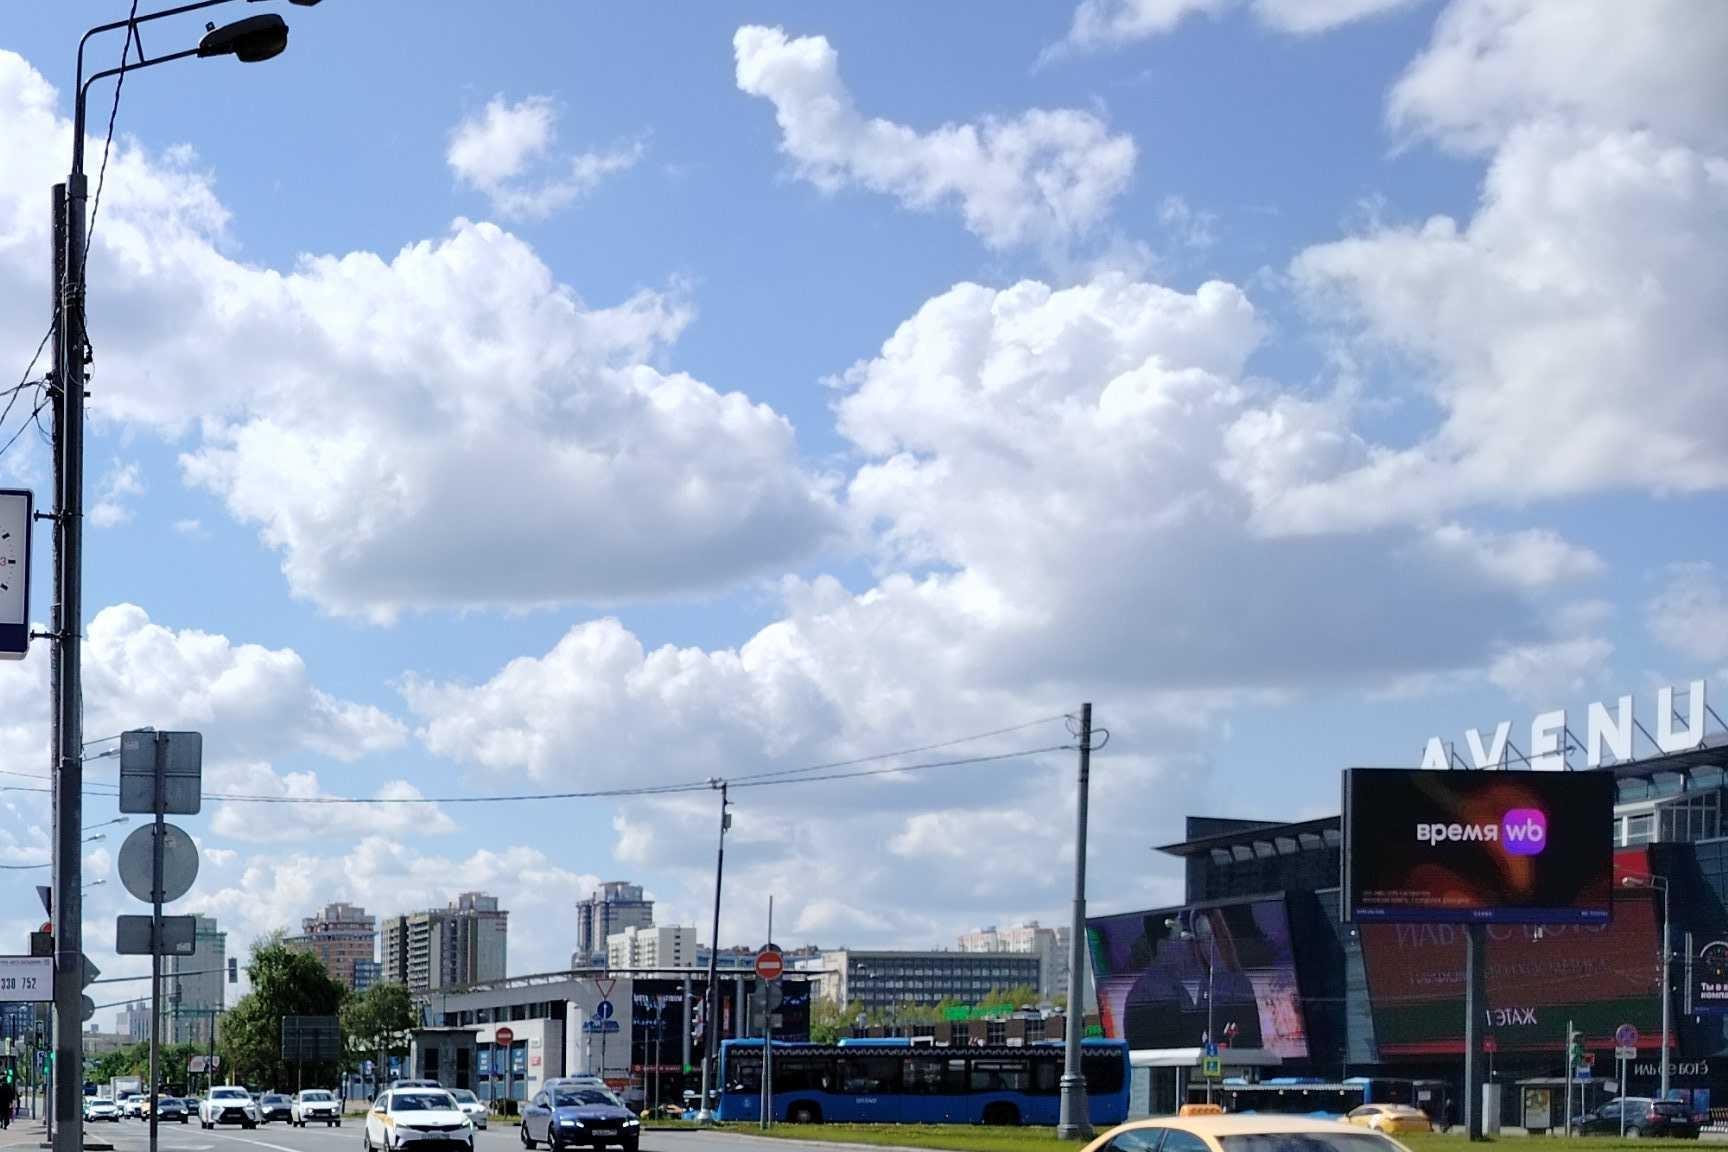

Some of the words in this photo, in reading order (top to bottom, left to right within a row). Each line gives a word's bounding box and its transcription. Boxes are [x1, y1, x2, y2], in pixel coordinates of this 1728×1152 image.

[0, 557, 7, 566] 3
[1416, 823, 1498, 845] время
[1505, 818, 1544, 842] wb
[1494, 1008, 1537, 1026] ЭТАЖ
